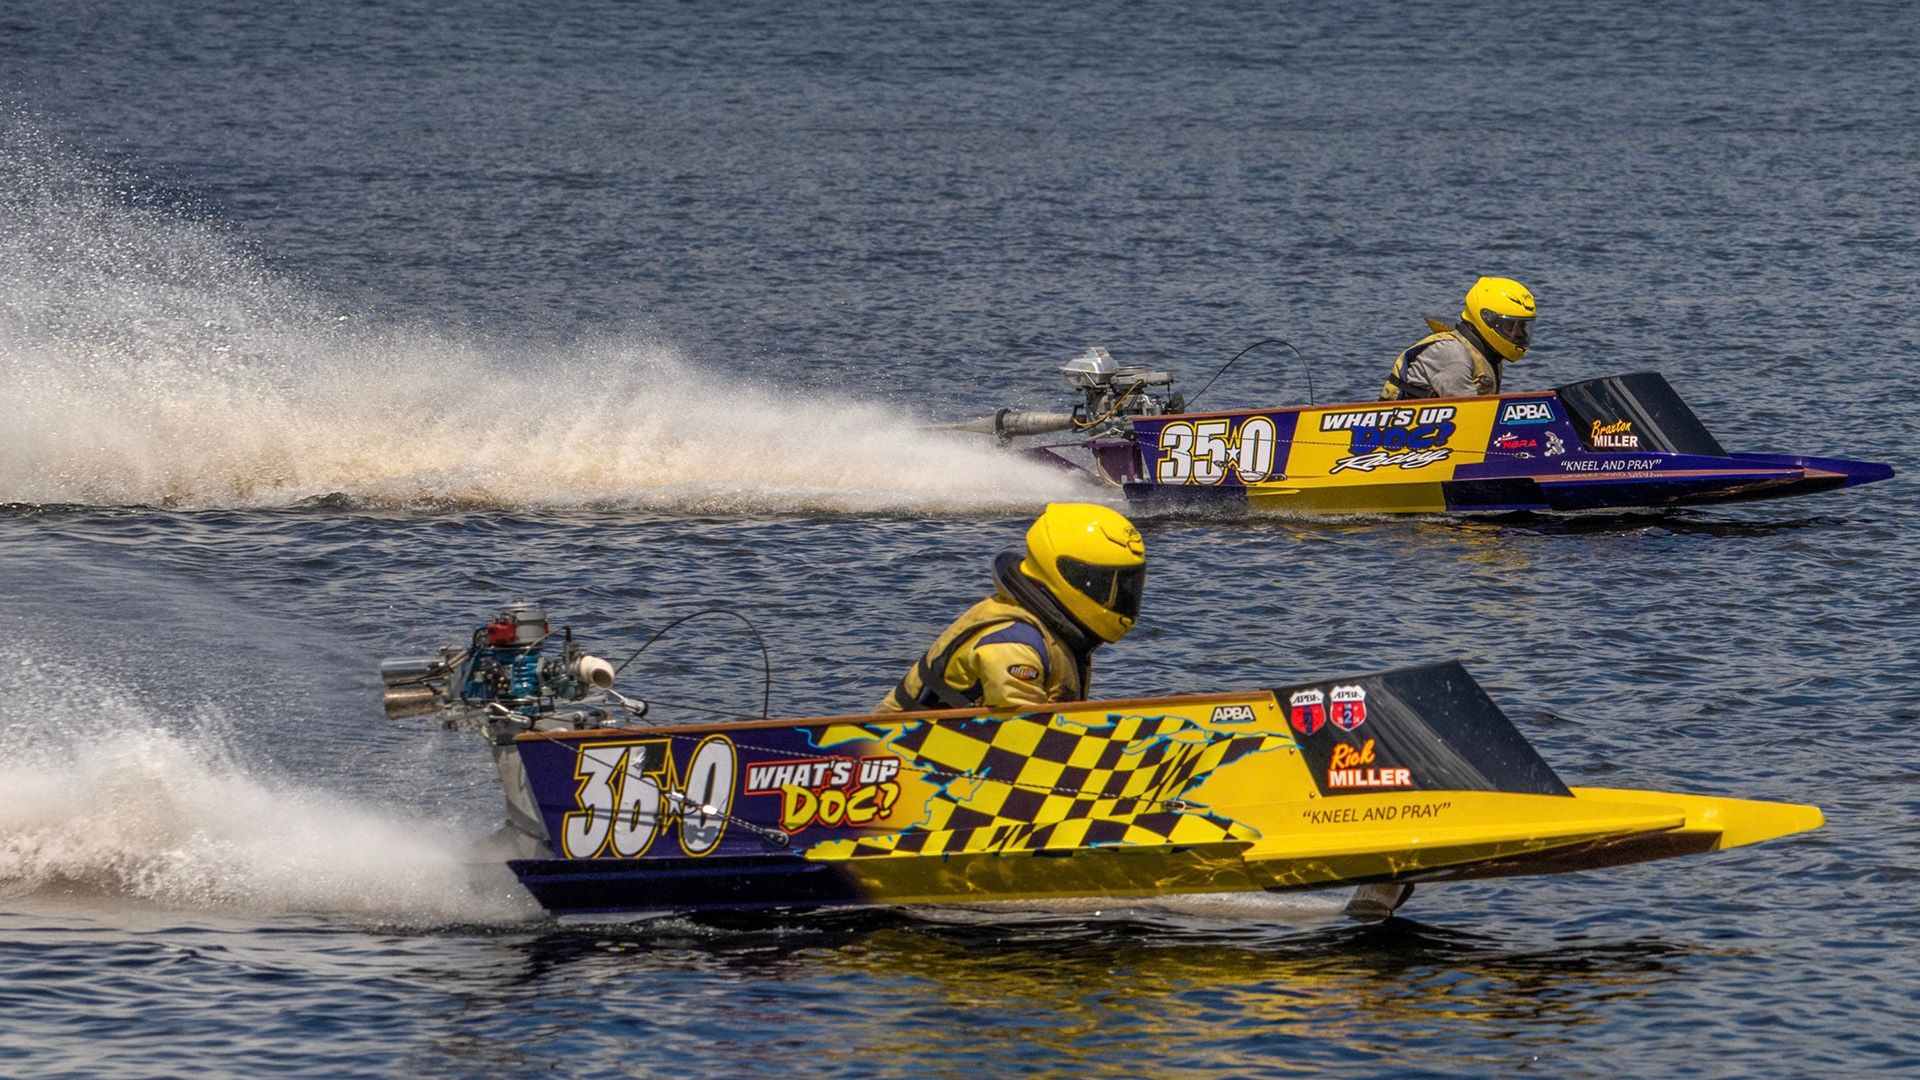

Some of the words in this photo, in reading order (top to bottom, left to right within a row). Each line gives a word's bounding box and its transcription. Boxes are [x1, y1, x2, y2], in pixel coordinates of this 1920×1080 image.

[1321, 408, 1415, 431] WHAT'S
[1418, 407, 1456, 424] UP
[1503, 404, 1552, 421] APBA
[1591, 420, 1632, 439] Braxton
[1594, 435, 1638, 447] MILLER
[1329, 448, 1453, 474] Racing
[1601, 461, 1626, 471] AND
[1212, 706, 1255, 721] APBA
[1331, 739, 1375, 769] Rick
[747, 759, 853, 790] WHAT'S
[859, 758, 899, 784] UP
[1328, 768, 1412, 787] MILLER
[782, 782, 900, 830] DOC?
[1362, 805, 1398, 821] AND
